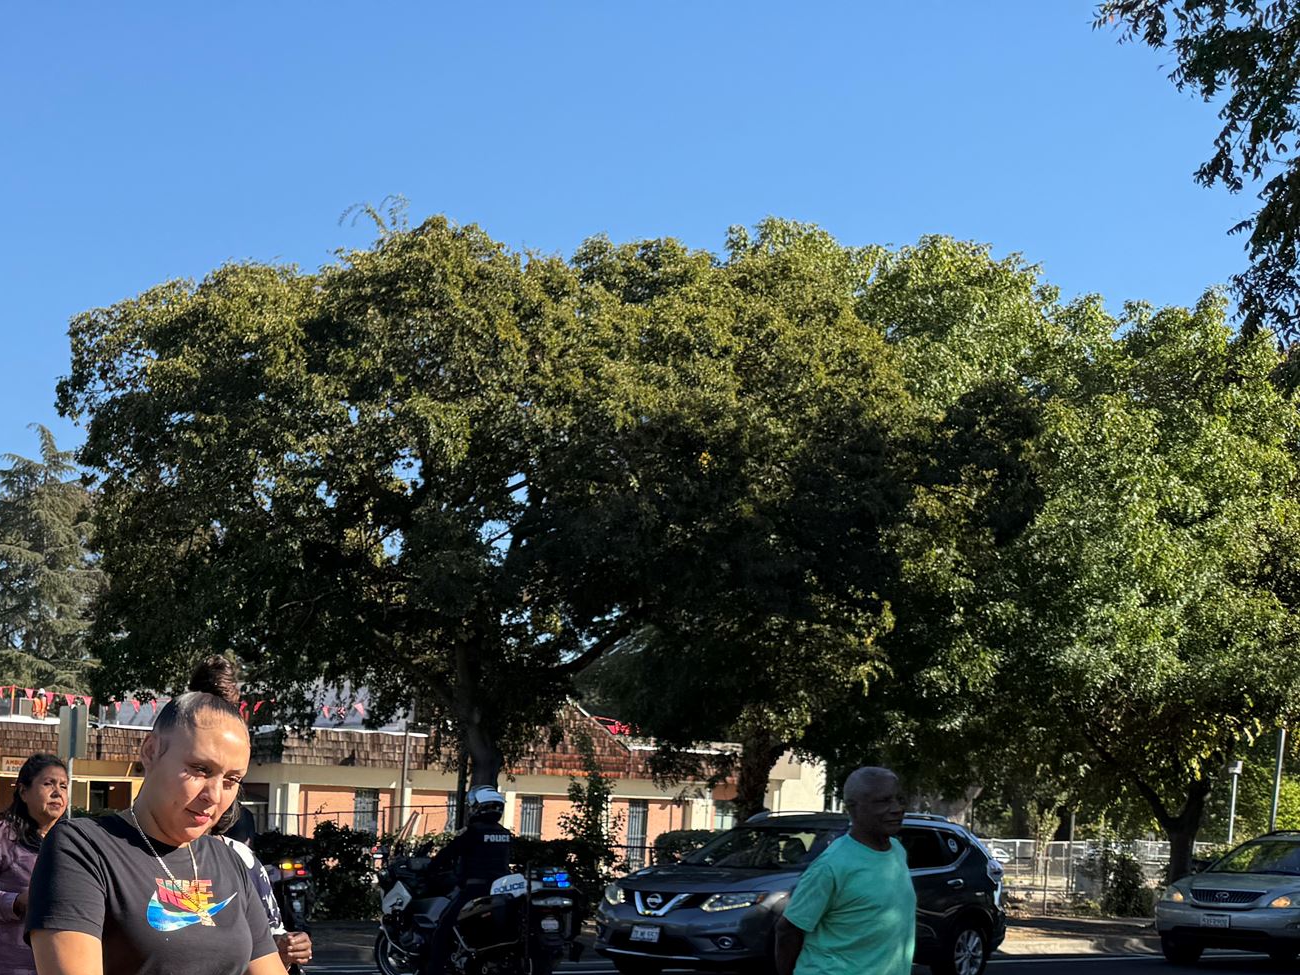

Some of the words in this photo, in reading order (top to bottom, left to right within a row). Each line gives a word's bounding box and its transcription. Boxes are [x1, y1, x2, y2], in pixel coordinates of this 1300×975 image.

[483, 834, 510, 843] POLICE
[493, 881, 525, 894] POLICE
[155, 877, 214, 913] NIKE
